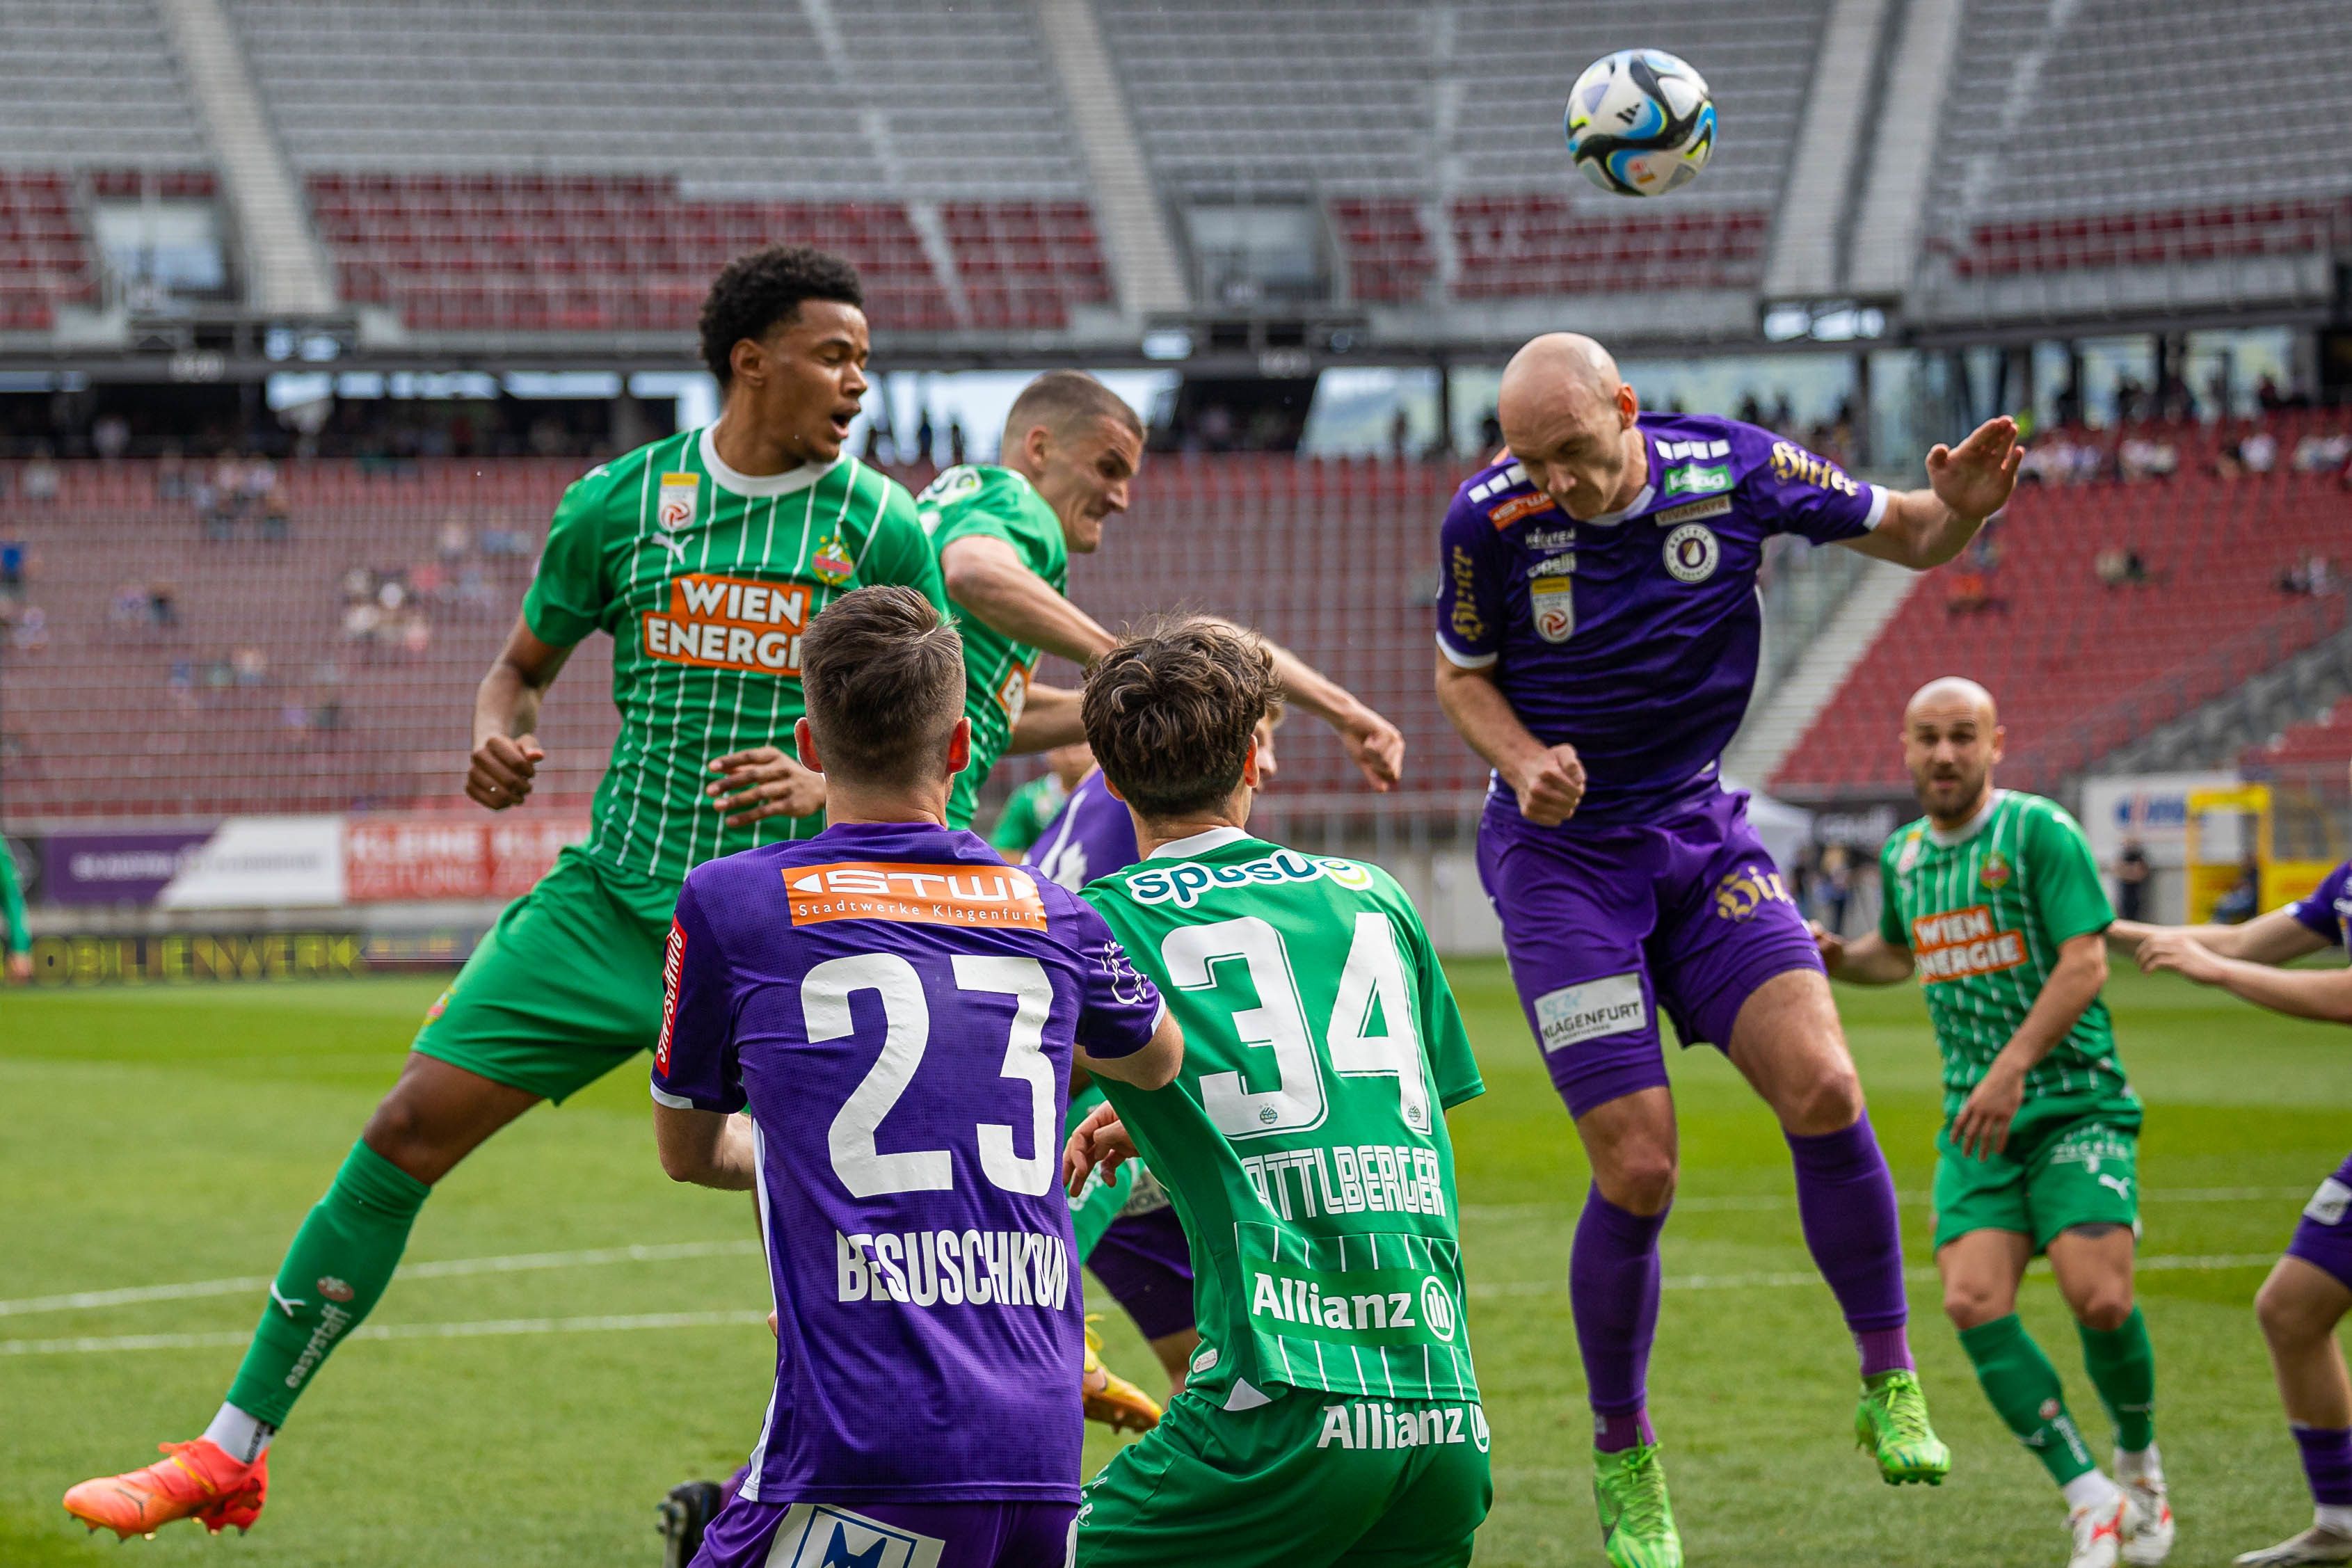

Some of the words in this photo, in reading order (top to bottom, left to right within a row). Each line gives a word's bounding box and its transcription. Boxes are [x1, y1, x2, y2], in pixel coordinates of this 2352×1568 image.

[679, 577, 804, 627] WIEN
[646, 616, 802, 670] ENERGI
[798, 898, 920, 917] Stadtwerke
[932, 904, 1042, 923] Klagenfurt
[825, 869, 1009, 902] STW
[1913, 909, 1990, 948] WIEN
[32, 934, 365, 985] OBILIENWERK
[1914, 934, 2022, 979] NERGIE
[1161, 912, 1433, 1142] 34
[1541, 1000, 1640, 1041] KLAGENFURT
[800, 952, 1056, 1198] 23
[1240, 1144, 1446, 1221] ATTLBERGER
[836, 1229, 1069, 1311] BESUSCHKOW
[1252, 1272, 1416, 1330] Allianz
[285, 1302, 352, 1389] easystaff
[1316, 1402, 1466, 1450] Allianz
